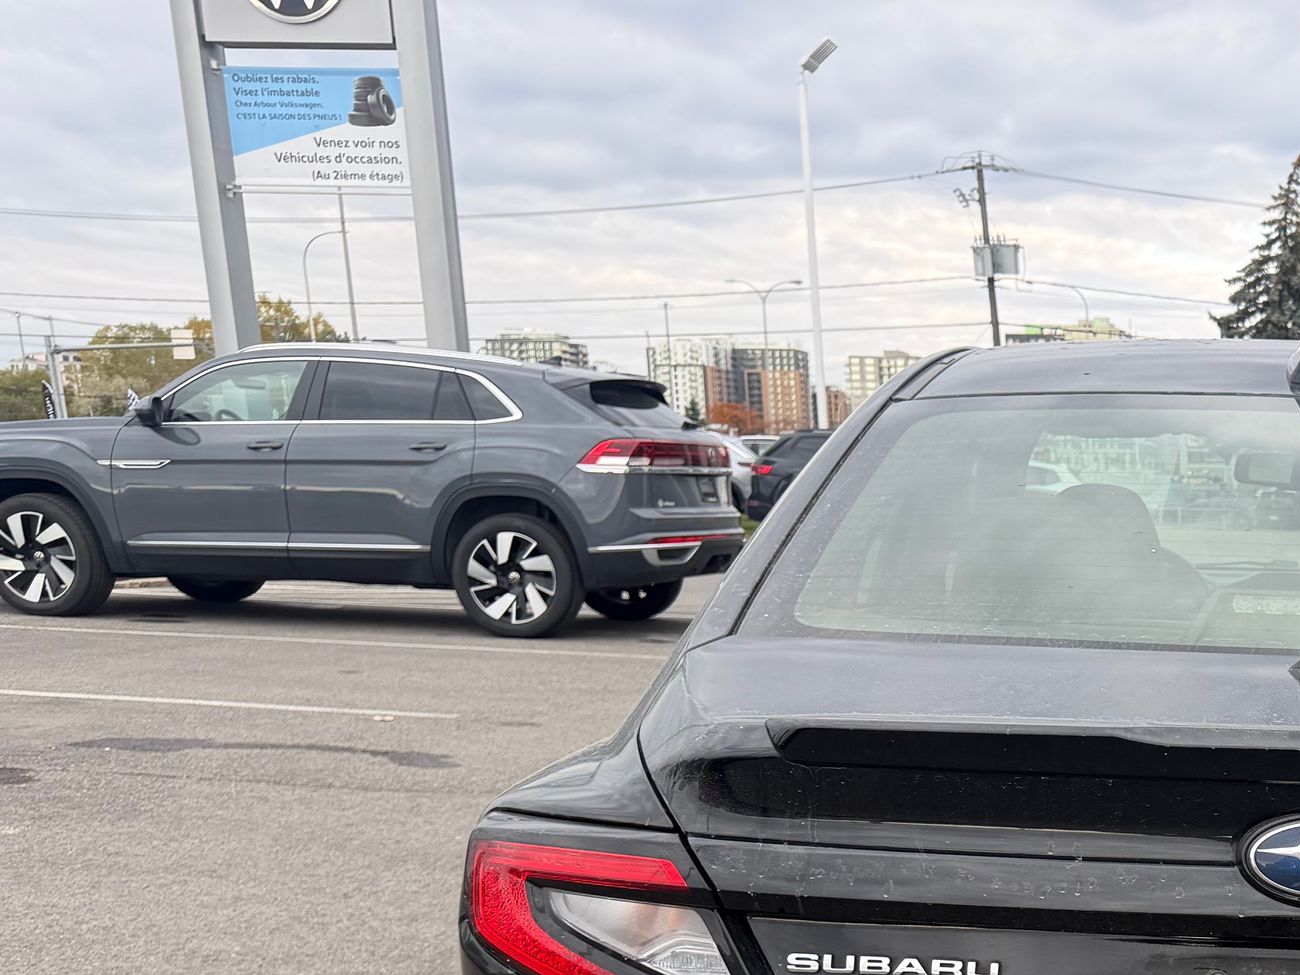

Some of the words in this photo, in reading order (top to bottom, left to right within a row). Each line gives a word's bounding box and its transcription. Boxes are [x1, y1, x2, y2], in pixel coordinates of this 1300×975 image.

[231, 73, 268, 84] Oubliez
[270, 73, 285, 84] les
[286, 74, 320, 84] rabais.
[233, 87, 259, 97] Visez
[261, 87, 321, 97] l'imbattable
[234, 100, 252, 108] Chez
[253, 100, 277, 108] Arbour
[236, 112, 256, 120] C'EST
[257, 112, 267, 120] LA
[268, 112, 296, 120] SAISON
[313, 137, 350, 148] Venez
[352, 137, 376, 149] voir
[379, 140, 400, 149] nos
[274, 151, 332, 164] Véhicules
[334, 152, 402, 165] d'occasion.
[312, 170, 330, 182] (Au
[333, 170, 366, 181] 2ième
[369, 171, 404, 183] étage)
